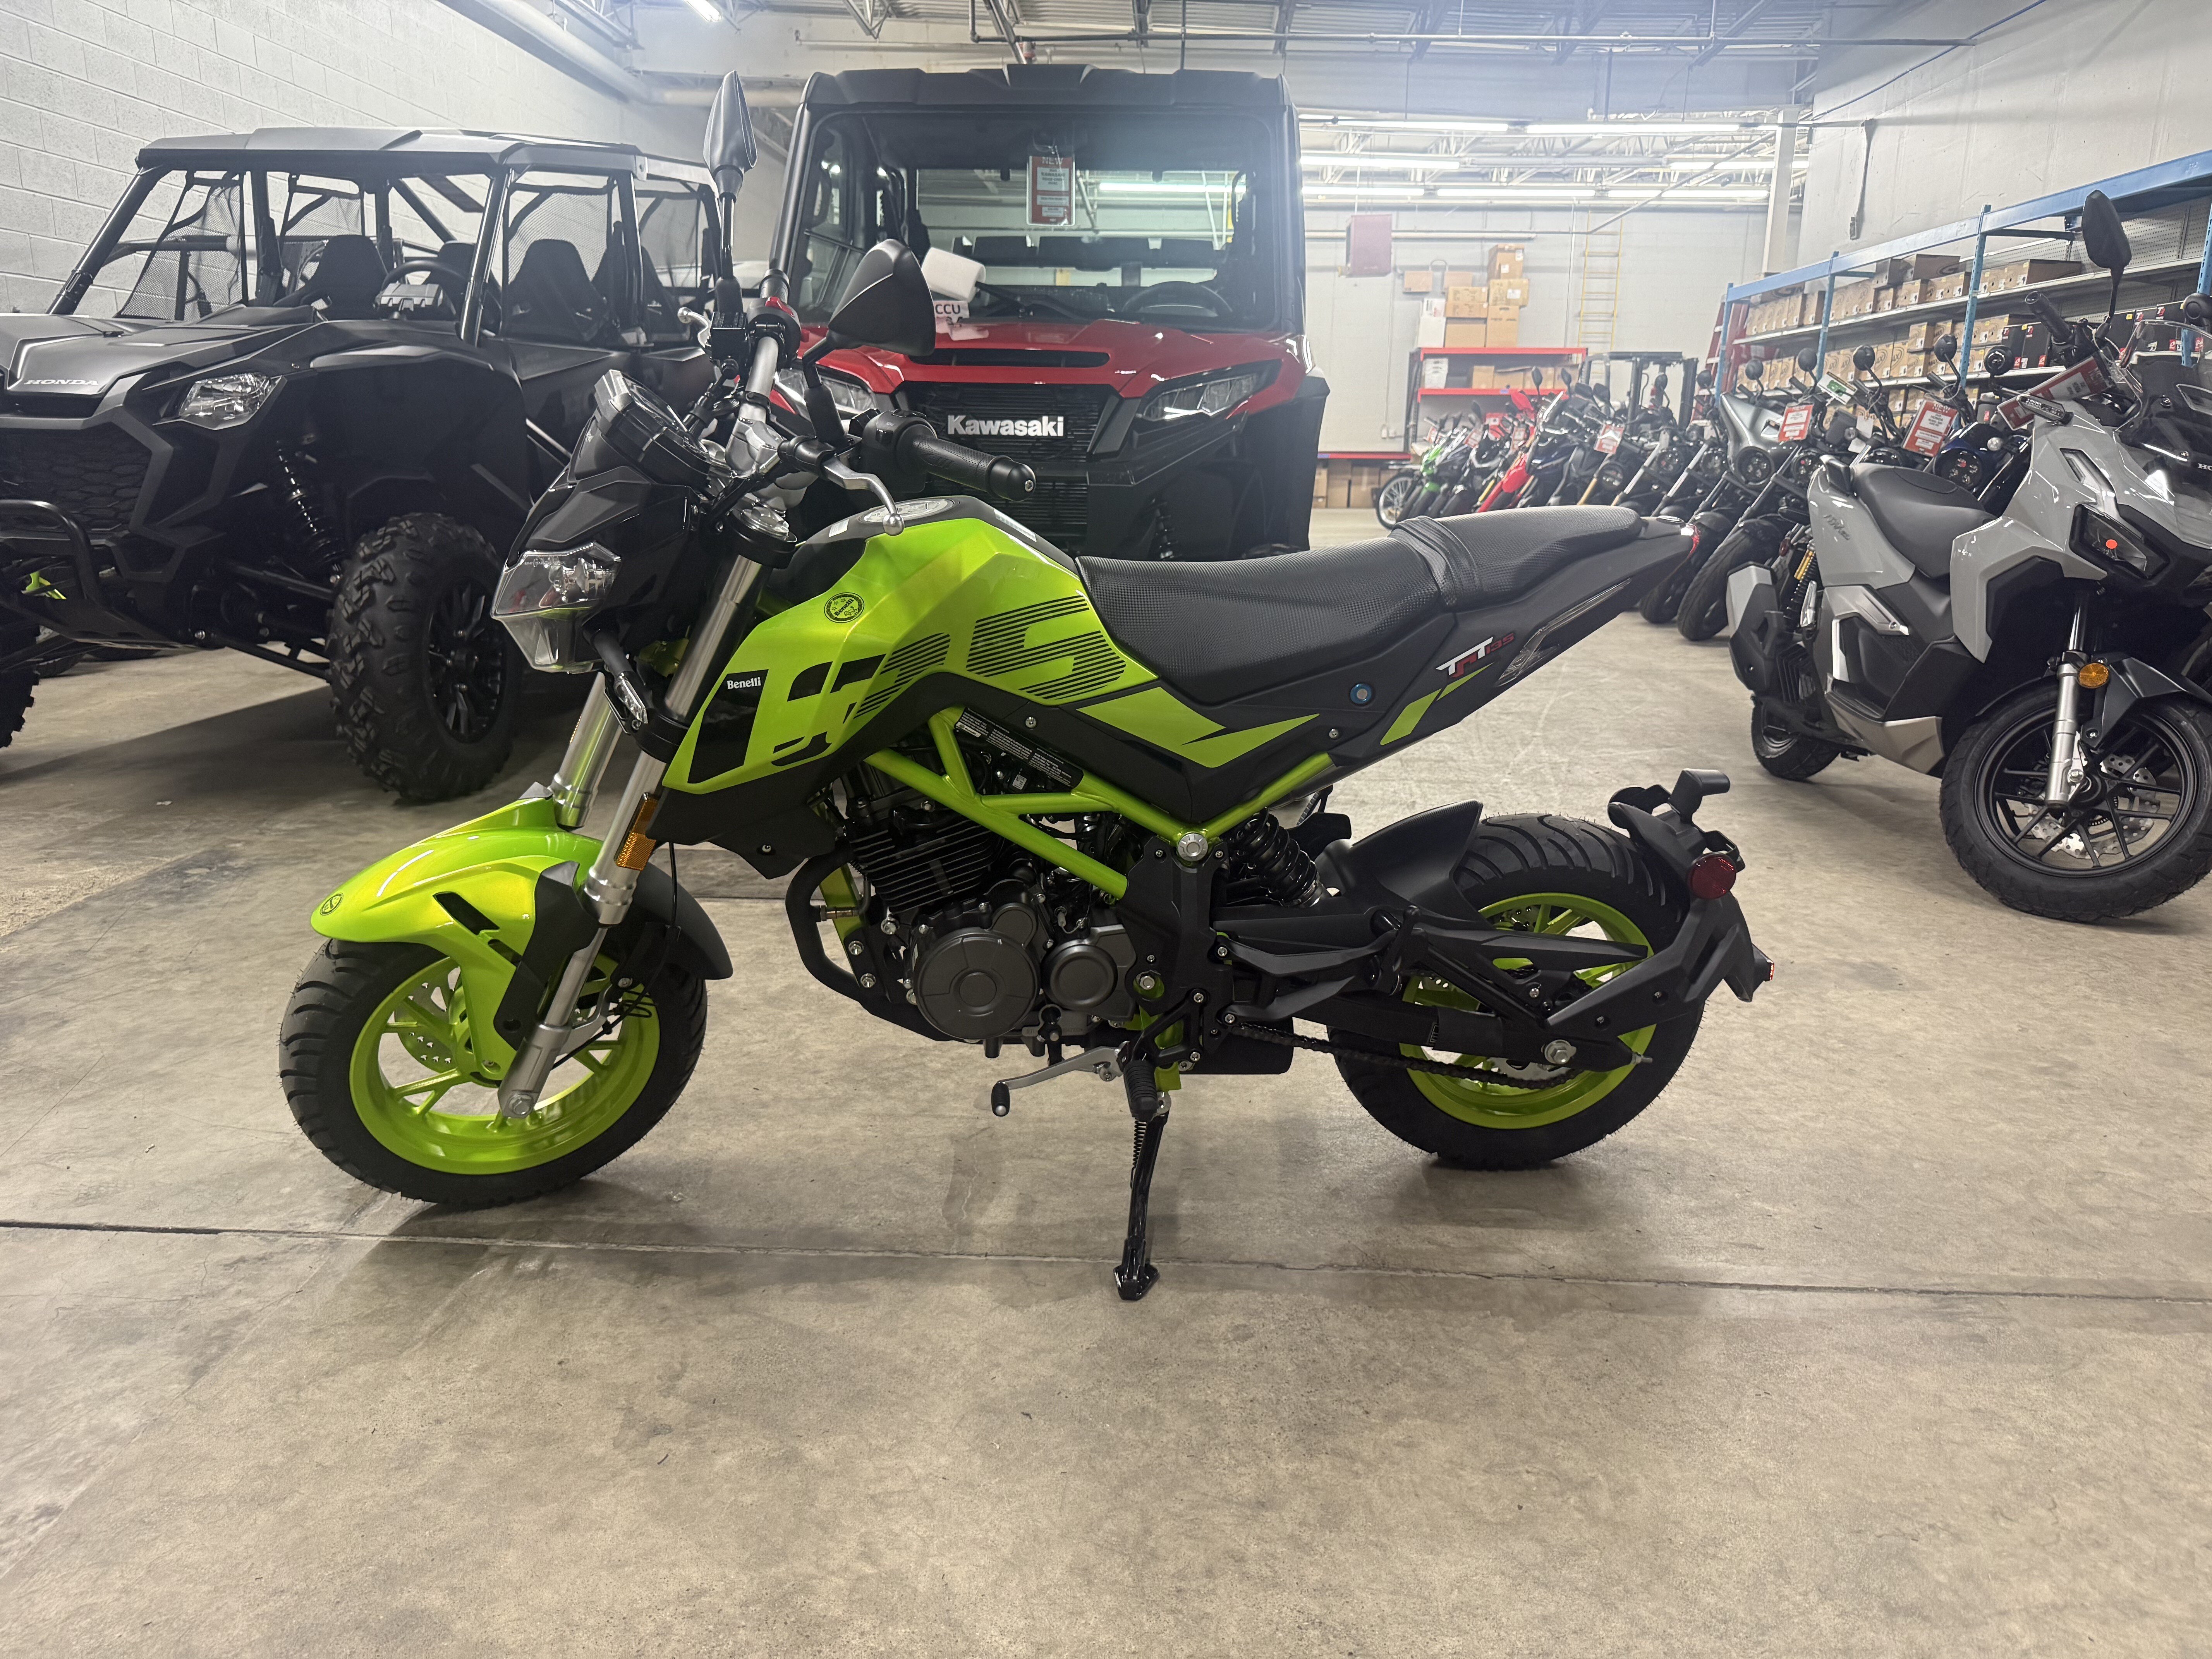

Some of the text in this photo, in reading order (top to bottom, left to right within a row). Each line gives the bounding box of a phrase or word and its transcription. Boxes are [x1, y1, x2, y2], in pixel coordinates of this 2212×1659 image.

[1042, 156, 1063, 165] NEW
[935, 304, 960, 314] CCU
[948, 415, 1064, 436] Kawasaki
[834, 598, 854, 616] Benelli
[727, 677, 761, 689] Benelli
